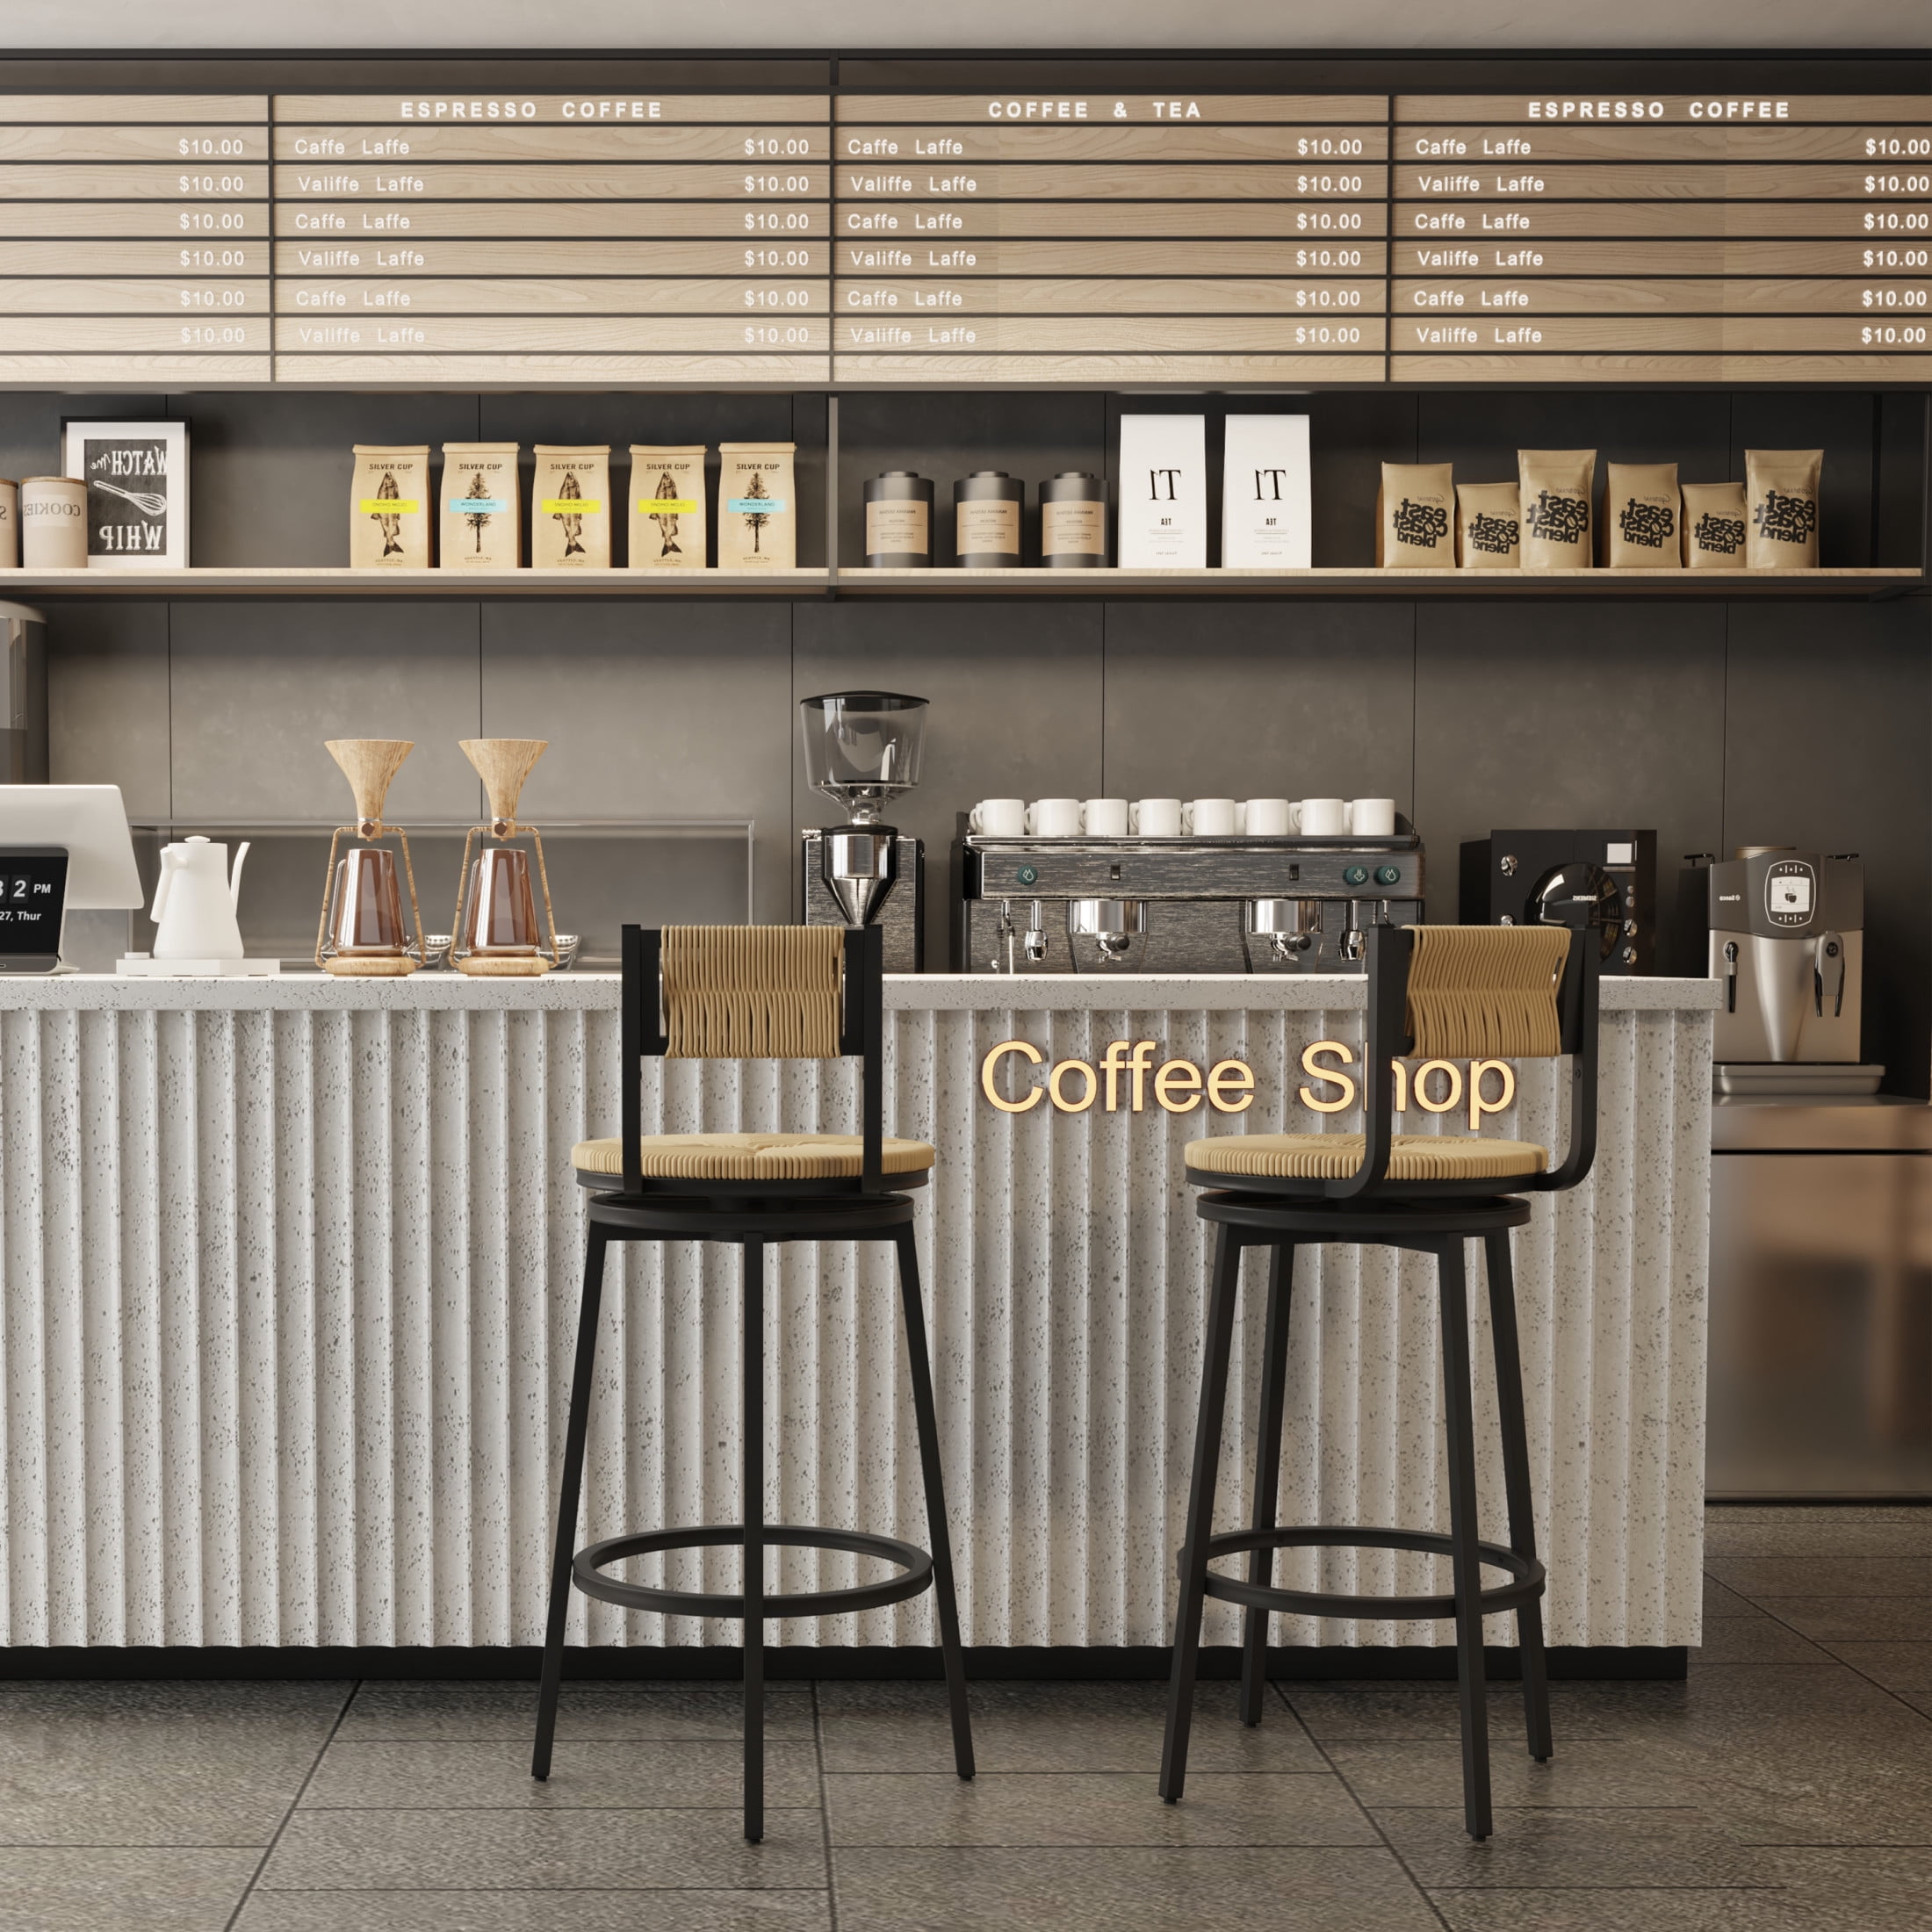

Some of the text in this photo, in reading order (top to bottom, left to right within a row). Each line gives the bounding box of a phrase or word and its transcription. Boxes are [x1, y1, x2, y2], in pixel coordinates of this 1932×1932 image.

[400, 101, 661, 119] ESPRESSO COFFEE
[988, 101, 1201, 119] COFFEE & TEA
[1528, 101, 1789, 119] ESPRESSO COFFEE
[178, 137, 243, 156] $10.00
[294, 137, 810, 156] Caffe Laffe $10.00
[847, 137, 1363, 156] Caffe Laffe $10.00
[1415, 137, 1931, 156] Caffe Laffe $10.00
[179, 174, 244, 193] $10.00
[298, 174, 810, 193] Valiffe Laffe $10.00
[850, 174, 1363, 193] Valiffe Laffe $10.00
[1417, 174, 1930, 193] Valiffe Laffe $10.00
[179, 213, 244, 232] $10.00
[295, 213, 810, 232] Caffe Laffe $10.00
[847, 213, 1362, 232] Caffe Laffe $10.00
[1414, 213, 1929, 232] Caffe Laffe $10.00
[180, 249, 245, 269] $10.00
[298, 249, 810, 269] Valiffe Laffe $10.00
[850, 249, 1362, 269] Valiffe Laffe $10.00
[1417, 249, 1928, 269] Valiffe Laffe $10.00
[180, 290, 245, 307] $10.00
[296, 290, 810, 307] Caffe Laffe $10.00
[847, 290, 1361, 307] Caffe Laffe $10.00
[1413, 290, 1928, 307] Caffe Laffe $10.00
[181, 327, 246, 344] $10.00
[299, 327, 810, 344] Valiffe Laffe $10.00
[850, 327, 1361, 344] Valiffe Laffe $10.00
[1416, 327, 1927, 344] Valiffe Laffe $10.00
[33, 883, 51, 894] PM
[17, 910, 42, 920] Thur
[982, 1039, 1256, 1113] Coffee
